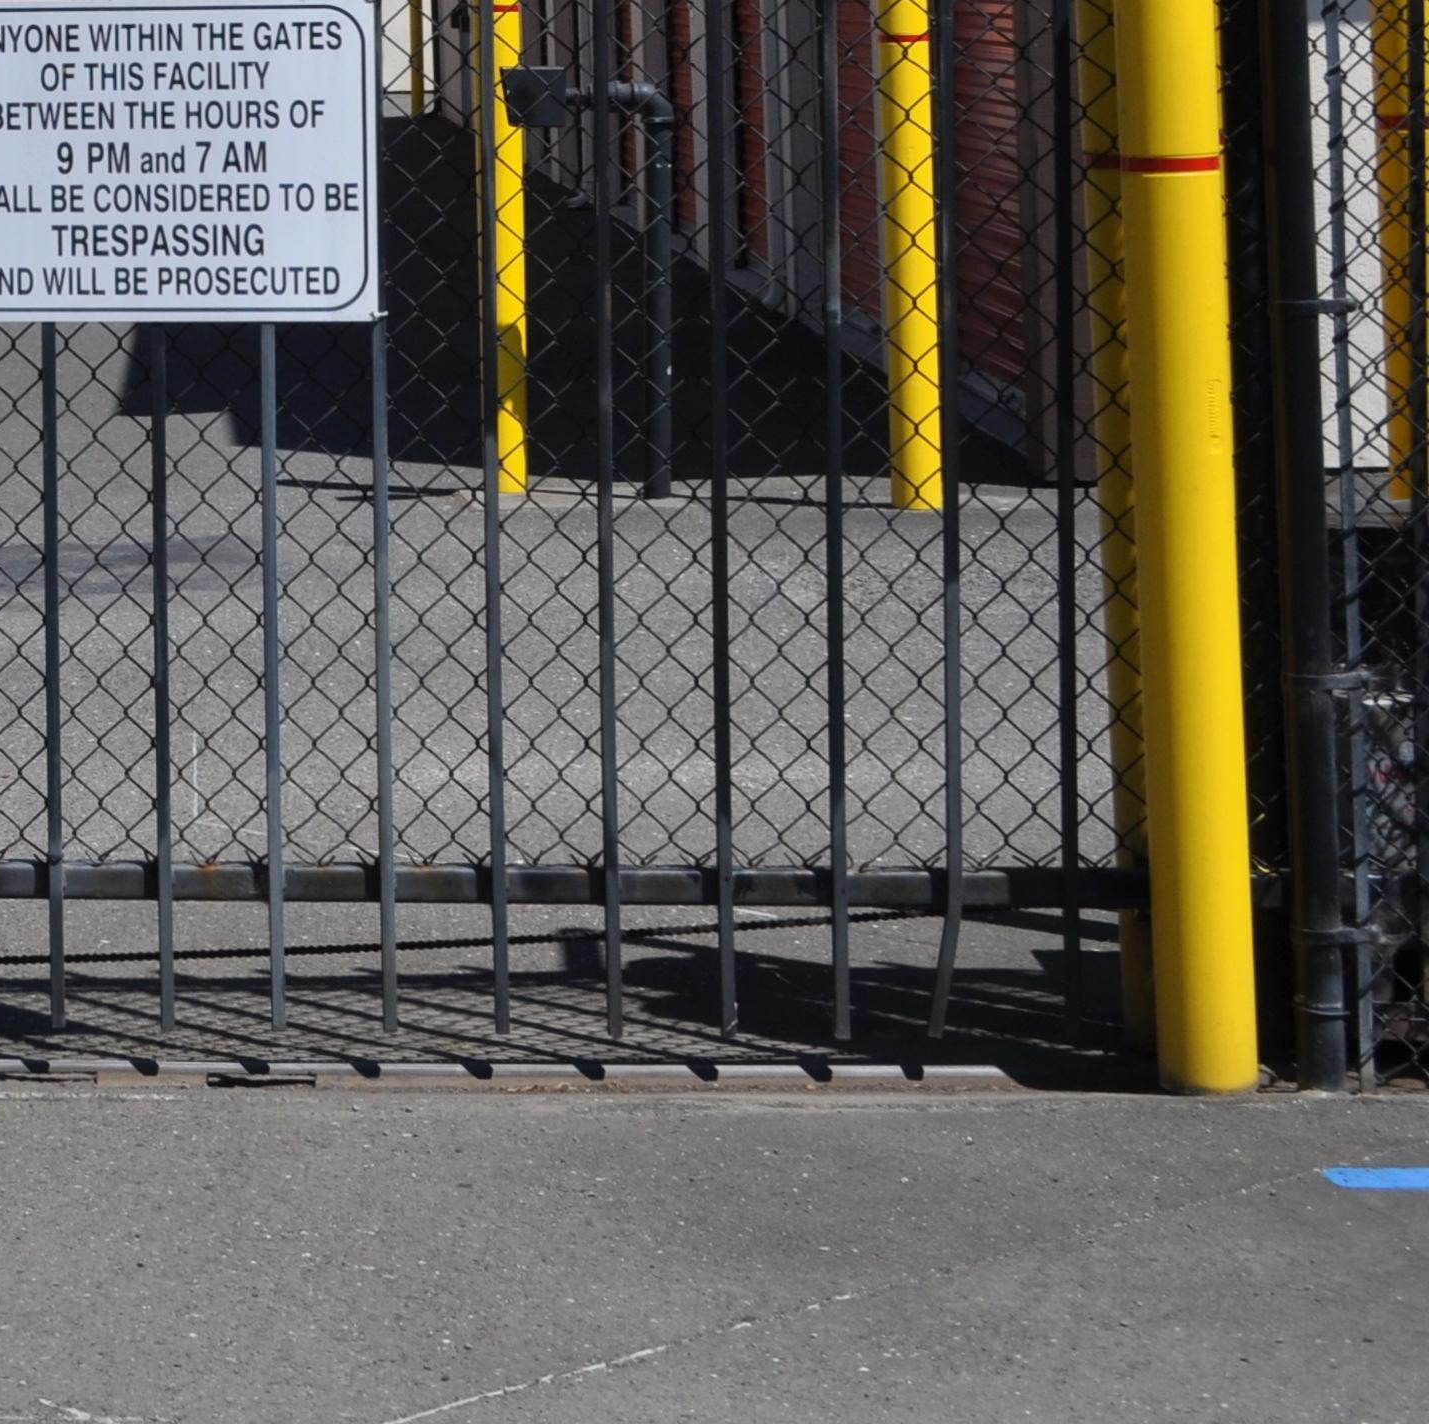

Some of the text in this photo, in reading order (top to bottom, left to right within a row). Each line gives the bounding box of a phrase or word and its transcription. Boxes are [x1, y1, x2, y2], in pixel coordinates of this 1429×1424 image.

[89, 24, 182, 51] WITHIN
[193, 23, 243, 50] THE
[254, 21, 341, 50] GATES
[41, 62, 269, 91] OF THIS FACILITY
[124, 102, 175, 129] THE
[186, 100, 279, 129] HOURS
[290, 100, 324, 128] OF
[57, 141, 266, 174] 9 PM and 7 AM
[51, 185, 84, 212] BE
[94, 184, 269, 212] CONSIDERED
[279, 183, 314, 211] TO
[325, 183, 358, 211] BE
[52, 224, 264, 256] TRESPASSING
[43, 268, 105, 295] WILL
[115, 267, 147, 295] BE
[158, 267, 339, 295] PROSECUTED
